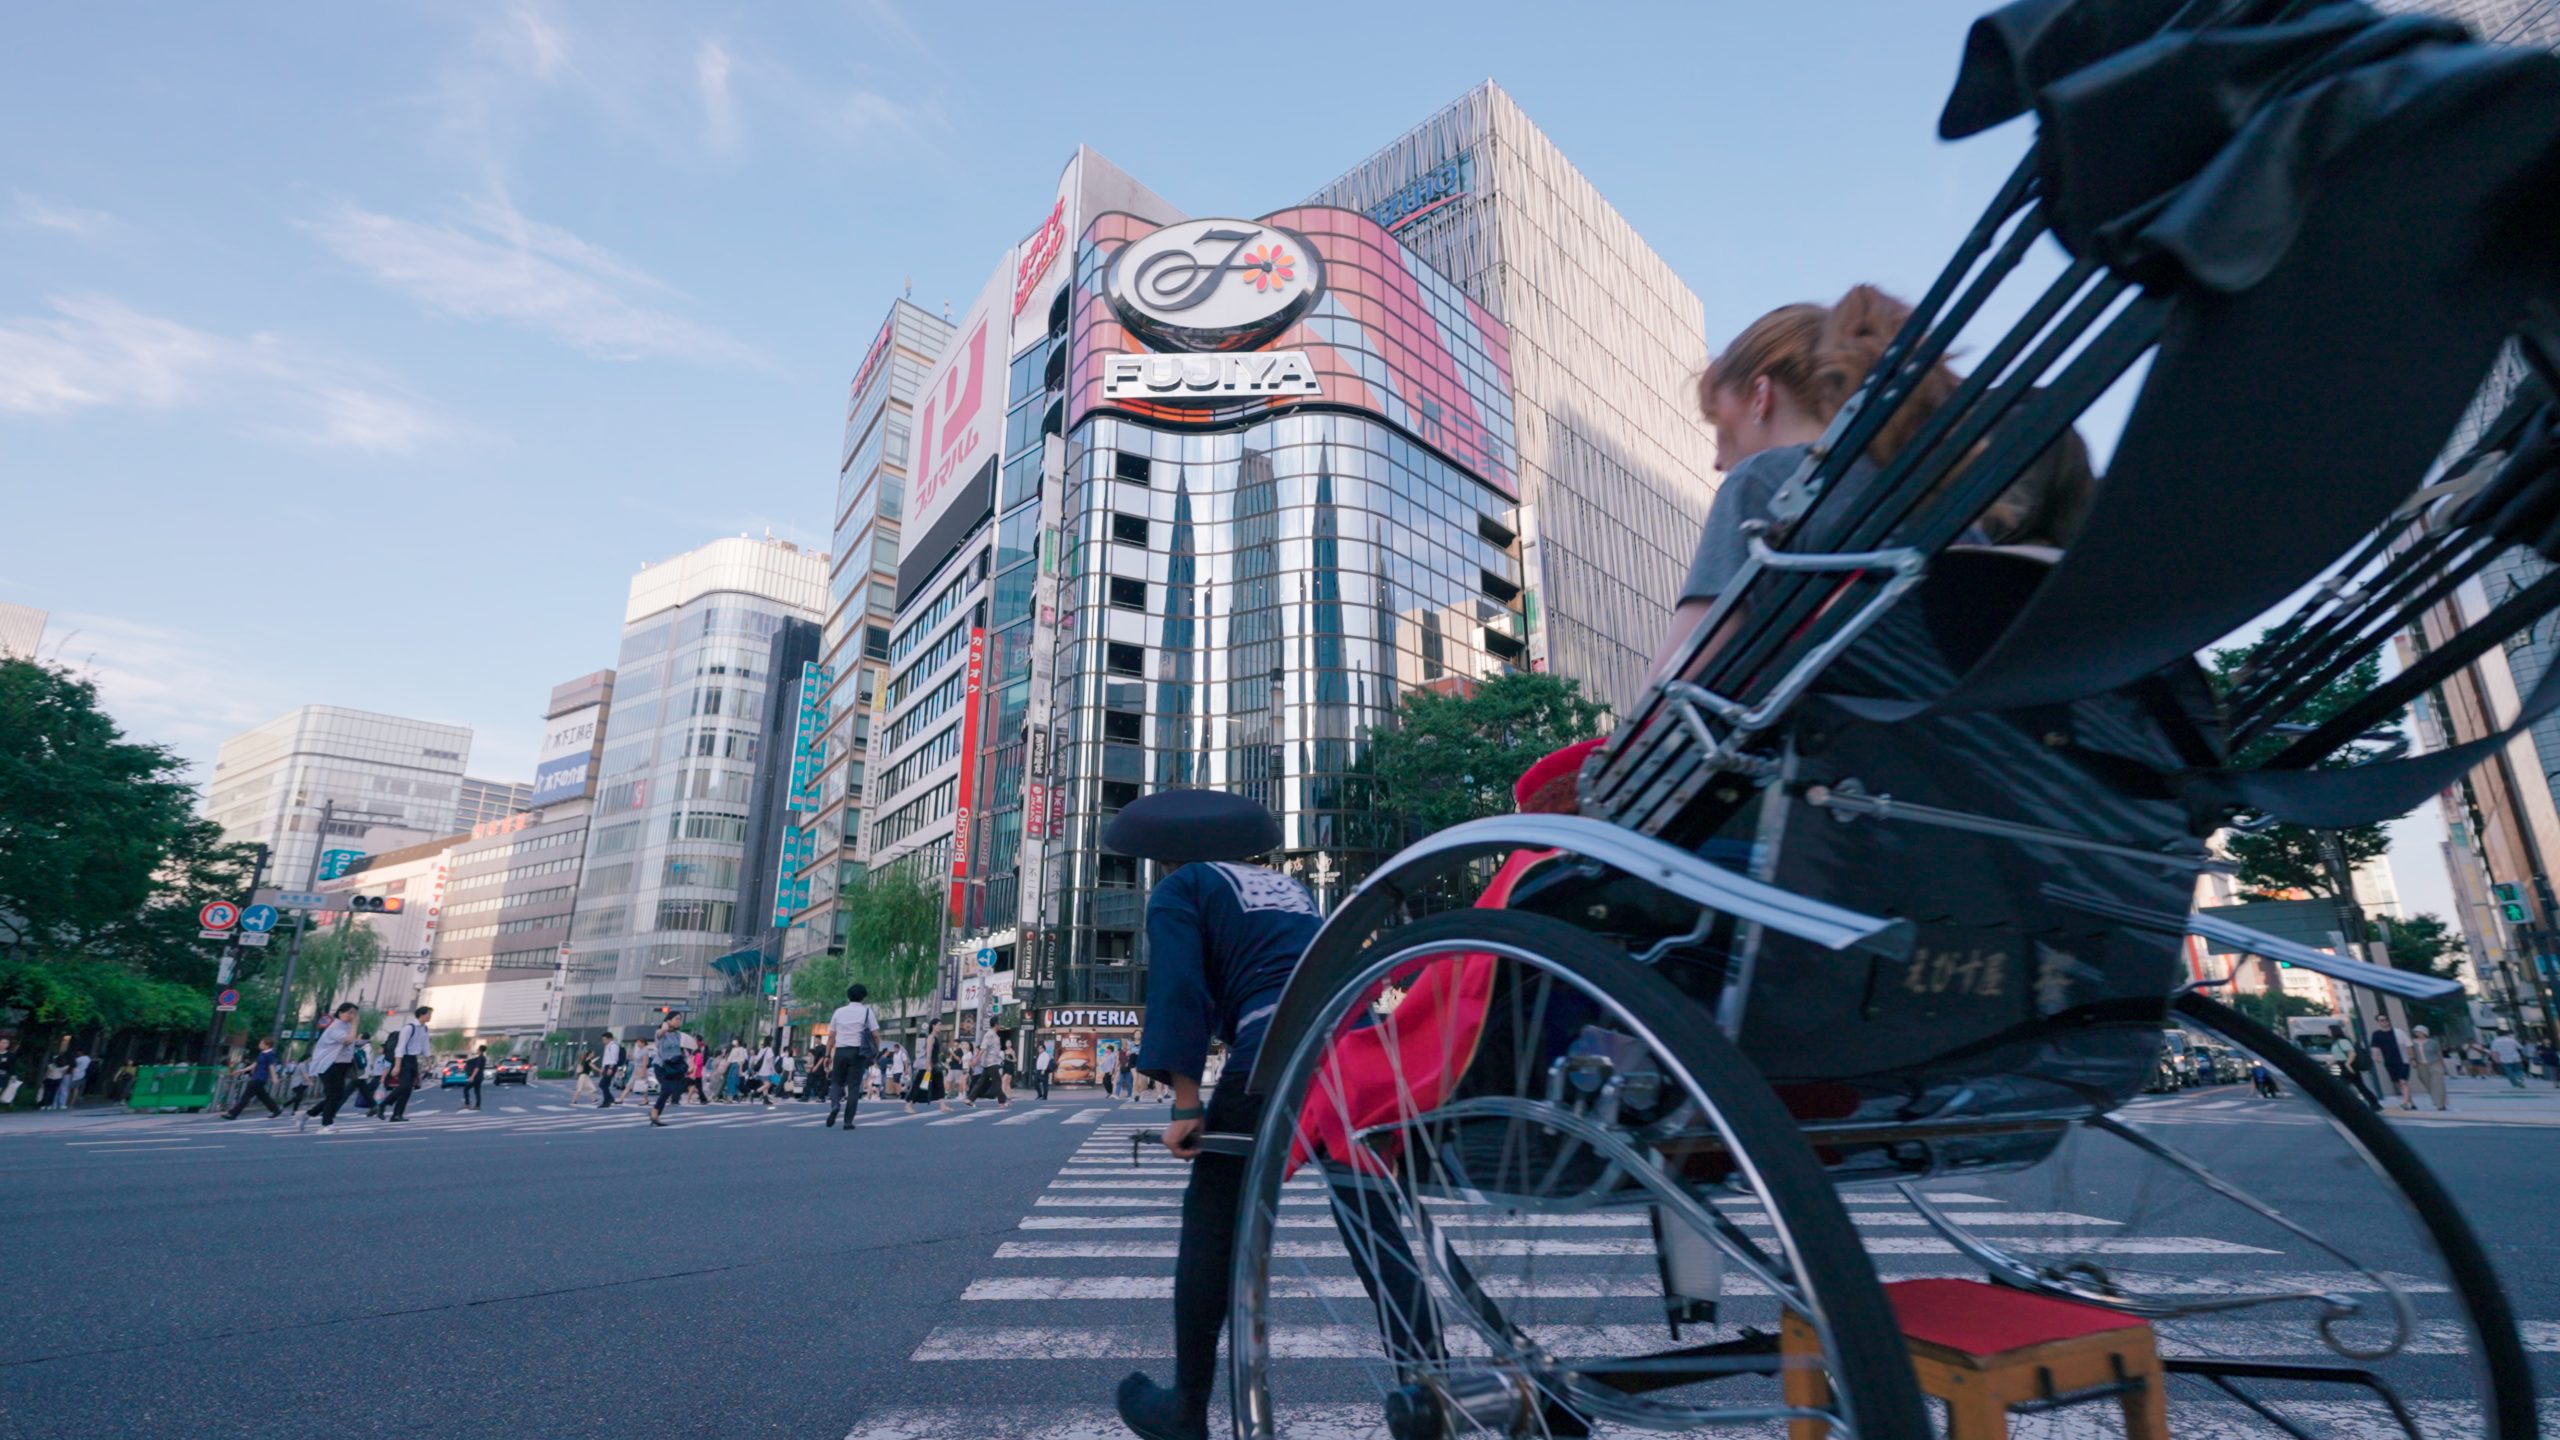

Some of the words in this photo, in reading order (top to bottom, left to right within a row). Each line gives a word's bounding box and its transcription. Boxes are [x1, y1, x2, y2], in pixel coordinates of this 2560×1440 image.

[1374, 165, 1457, 227] IZUHO
[1106, 356, 1317, 392] FUJIYA
[915, 426, 980, 520] プリマハム
[968, 636, 983, 694] カラオケ
[1025, 940, 1033, 979] LOTTERIA
[1053, 1010, 1139, 1026] LOTTERIA
